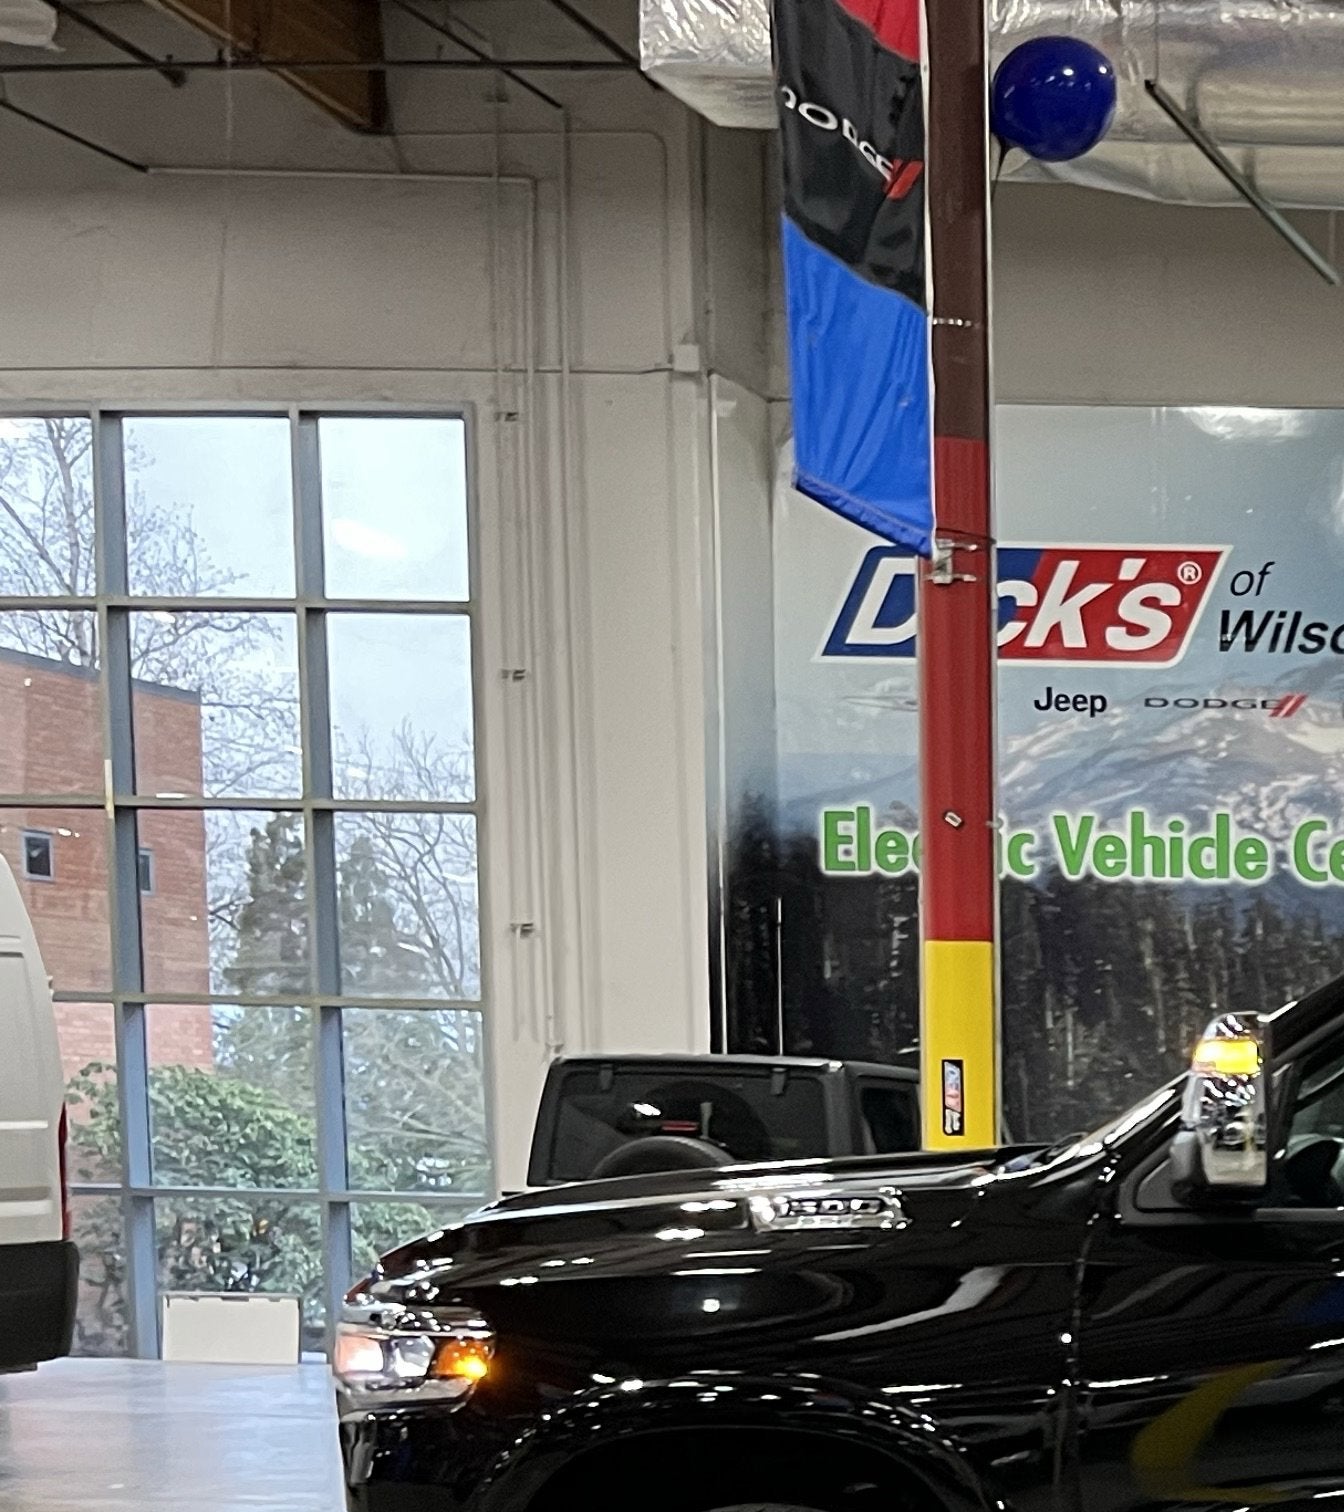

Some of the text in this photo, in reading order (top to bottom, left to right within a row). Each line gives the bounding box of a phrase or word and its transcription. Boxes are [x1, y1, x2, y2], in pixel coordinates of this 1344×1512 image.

[1230, 561, 1275, 596] of
[1034, 687, 1108, 718] Jeep
[1143, 697, 1281, 710] DODGE
[1053, 811, 1268, 878] Vehicle
